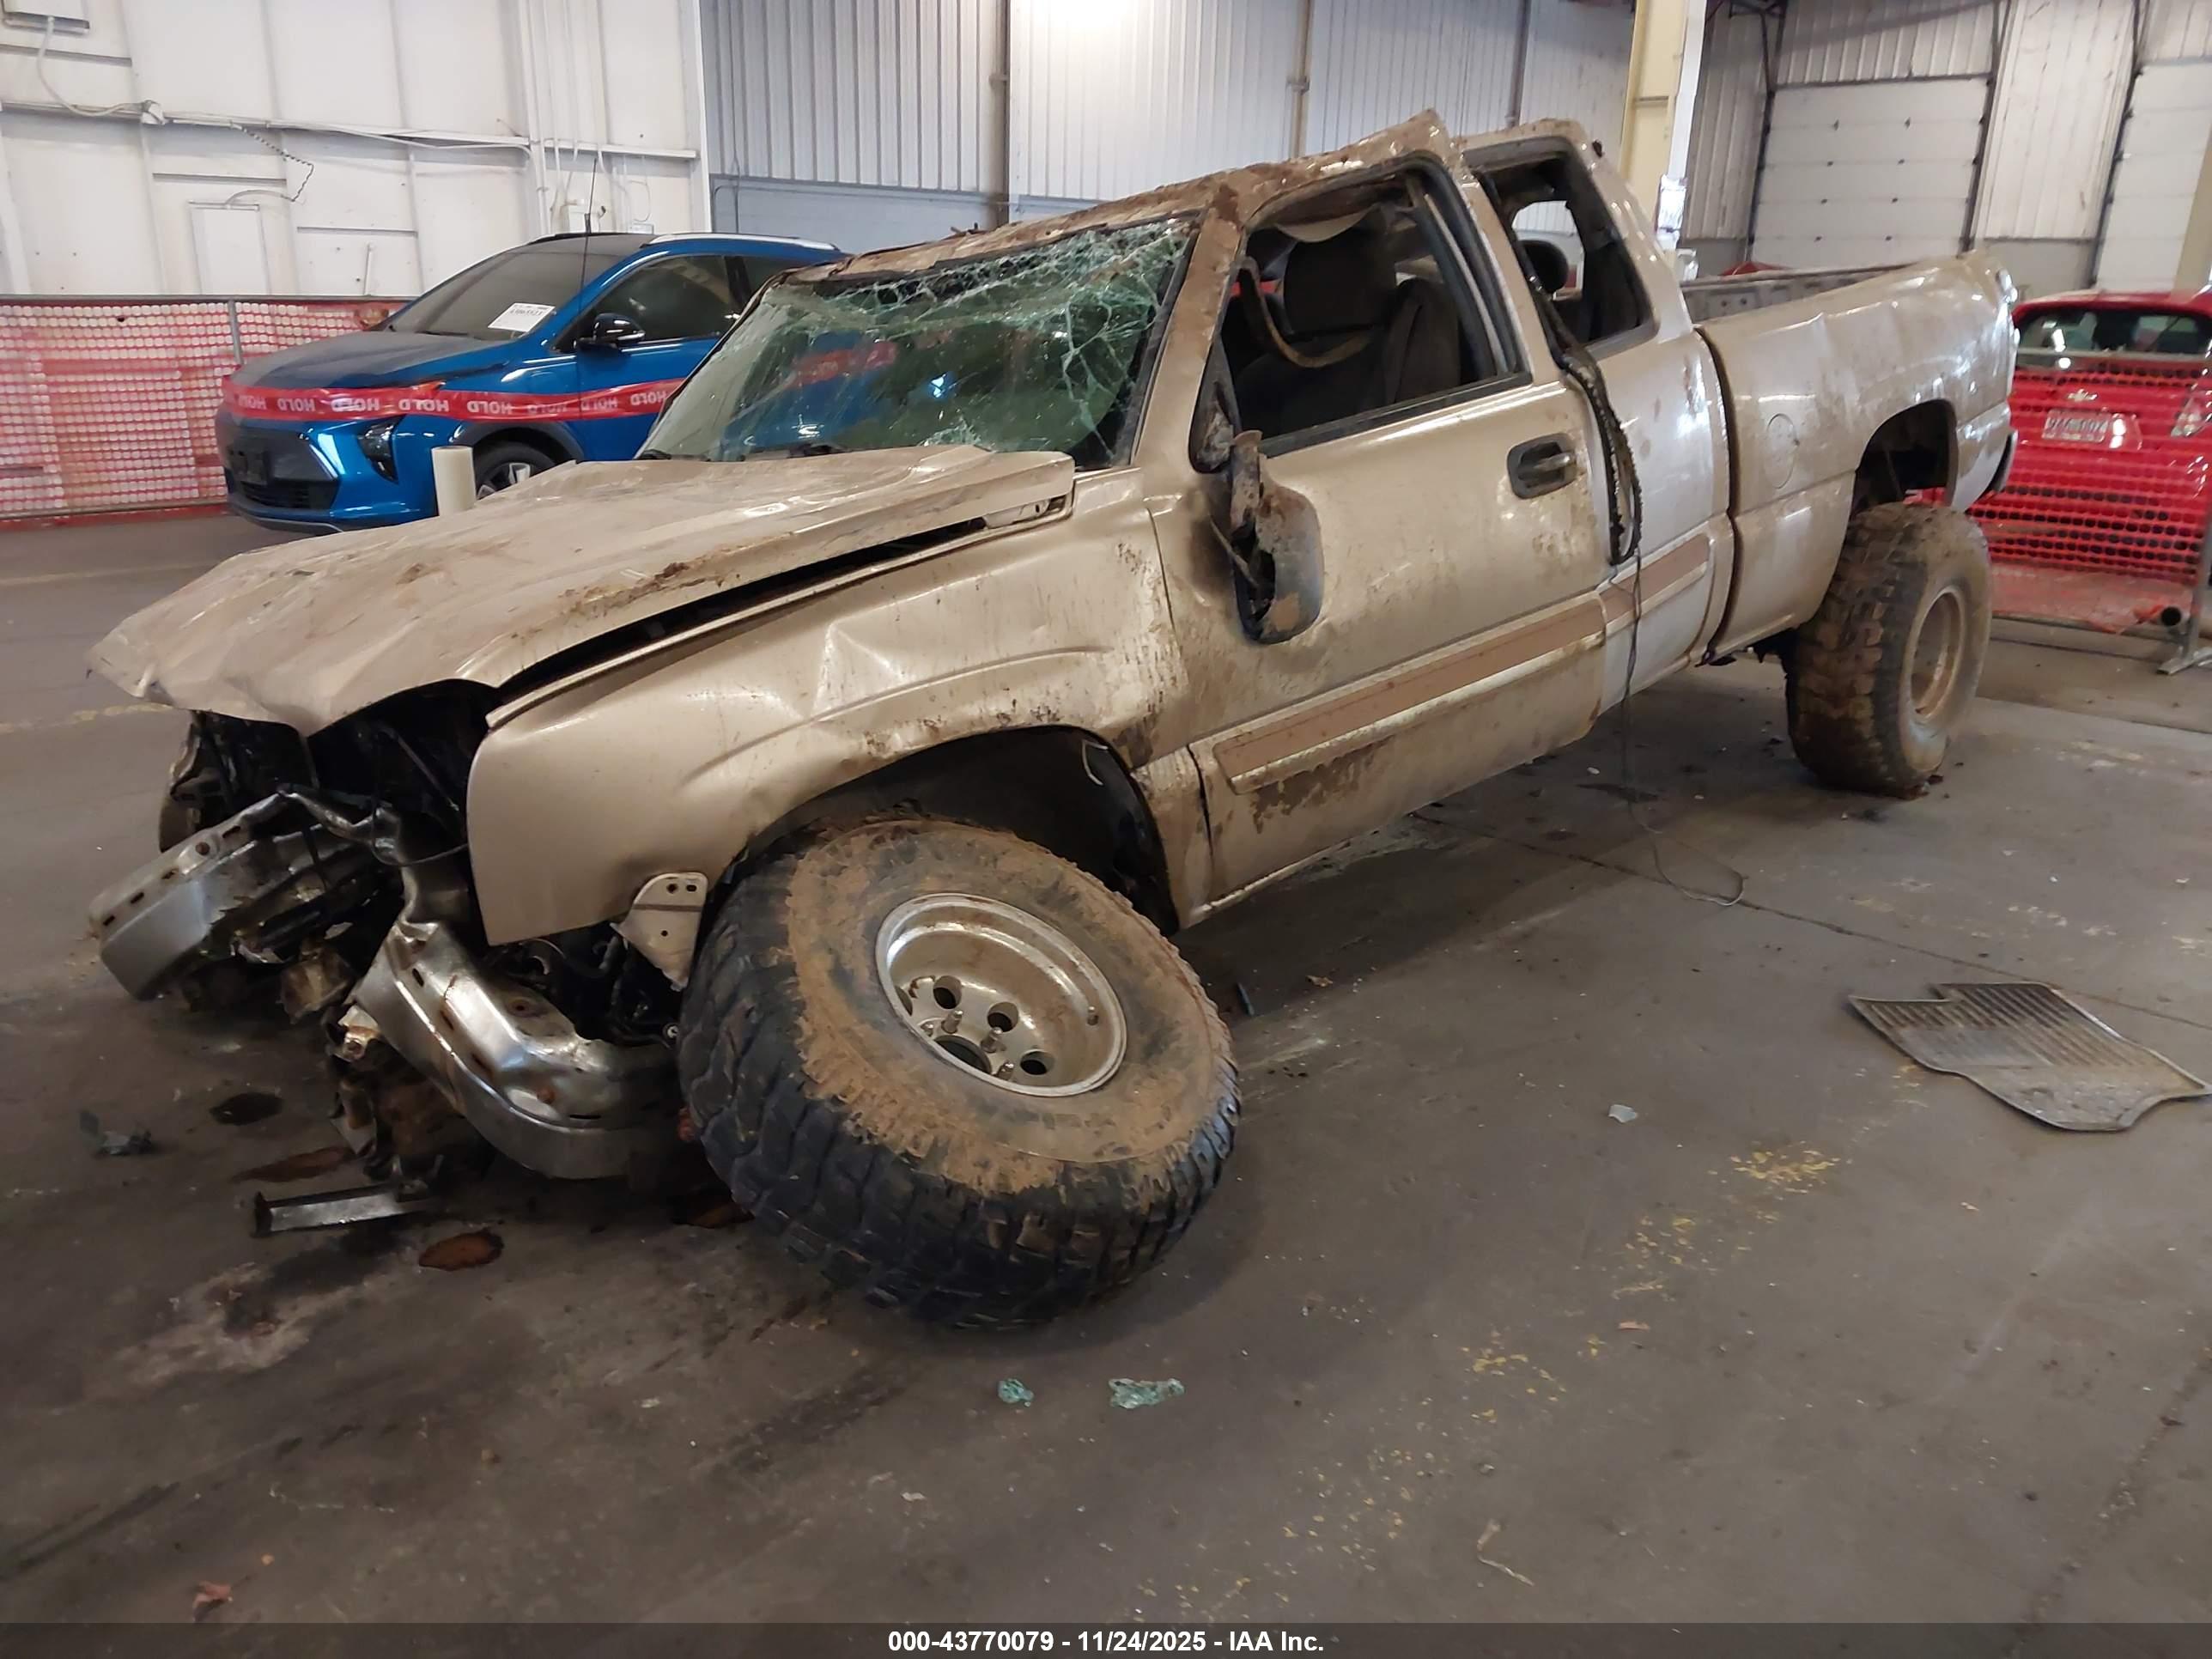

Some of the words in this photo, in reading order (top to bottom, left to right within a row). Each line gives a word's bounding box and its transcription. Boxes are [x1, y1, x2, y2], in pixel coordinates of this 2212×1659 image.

[277, 398, 316, 411] HOLD
[330, 398, 380, 411] HOLD
[398, 398, 449, 411] HOLD
[580, 396, 618, 411] HOLD
[630, 392, 667, 406] HOLD
[466, 400, 513, 415] HOLD
